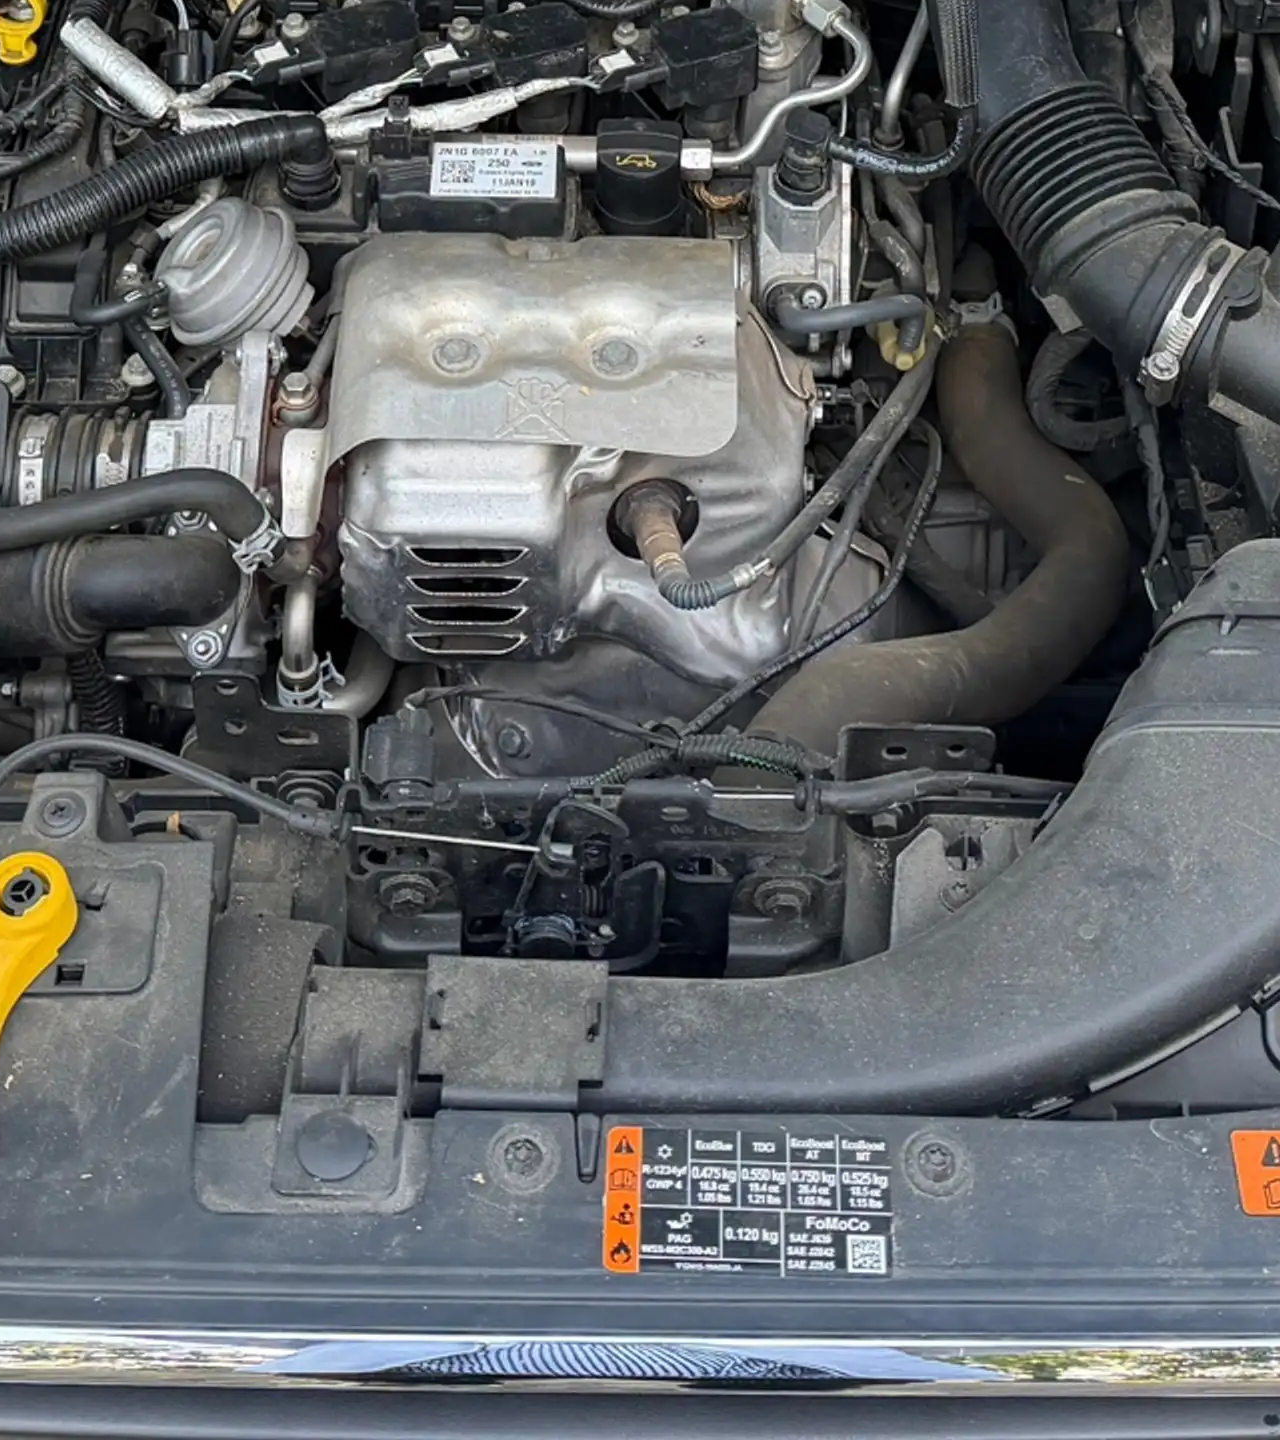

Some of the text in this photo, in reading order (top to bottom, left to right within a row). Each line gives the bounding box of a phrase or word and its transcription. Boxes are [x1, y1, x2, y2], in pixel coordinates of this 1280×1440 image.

[790, 1137, 835, 1149] EcoBoost
[841, 1139, 886, 1151] EcoBoost
[805, 1149, 821, 1160] AT
[642, 1163, 688, 1178] R-1234yf
[691, 1165, 738, 1183] 0.475 kg
[741, 1167, 787, 1186] 0.550 kg
[646, 1178, 683, 1190] GWP 4
[791, 1169, 836, 1187] 0.750 kg
[841, 1171, 889, 1190] 0.525 kg
[718, 1183, 731, 1192] oz
[768, 1184, 781, 1194] oz
[818, 1186, 831, 1195] oz
[869, 1188, 882, 1198] oz
[717, 1192, 732, 1204] lbs
[766, 1193, 782, 1205] lbs
[817, 1195, 832, 1207] lbs
[867, 1197, 884, 1209] lbs
[805, 1215, 872, 1232] FoMoCo
[667, 1233, 693, 1244] PAG
[724, 1226, 779, 1246] 0.120 kg
[788, 1232, 809, 1243] SAE
[786, 1245, 807, 1257] SAE
[786, 1259, 807, 1270] SAE
